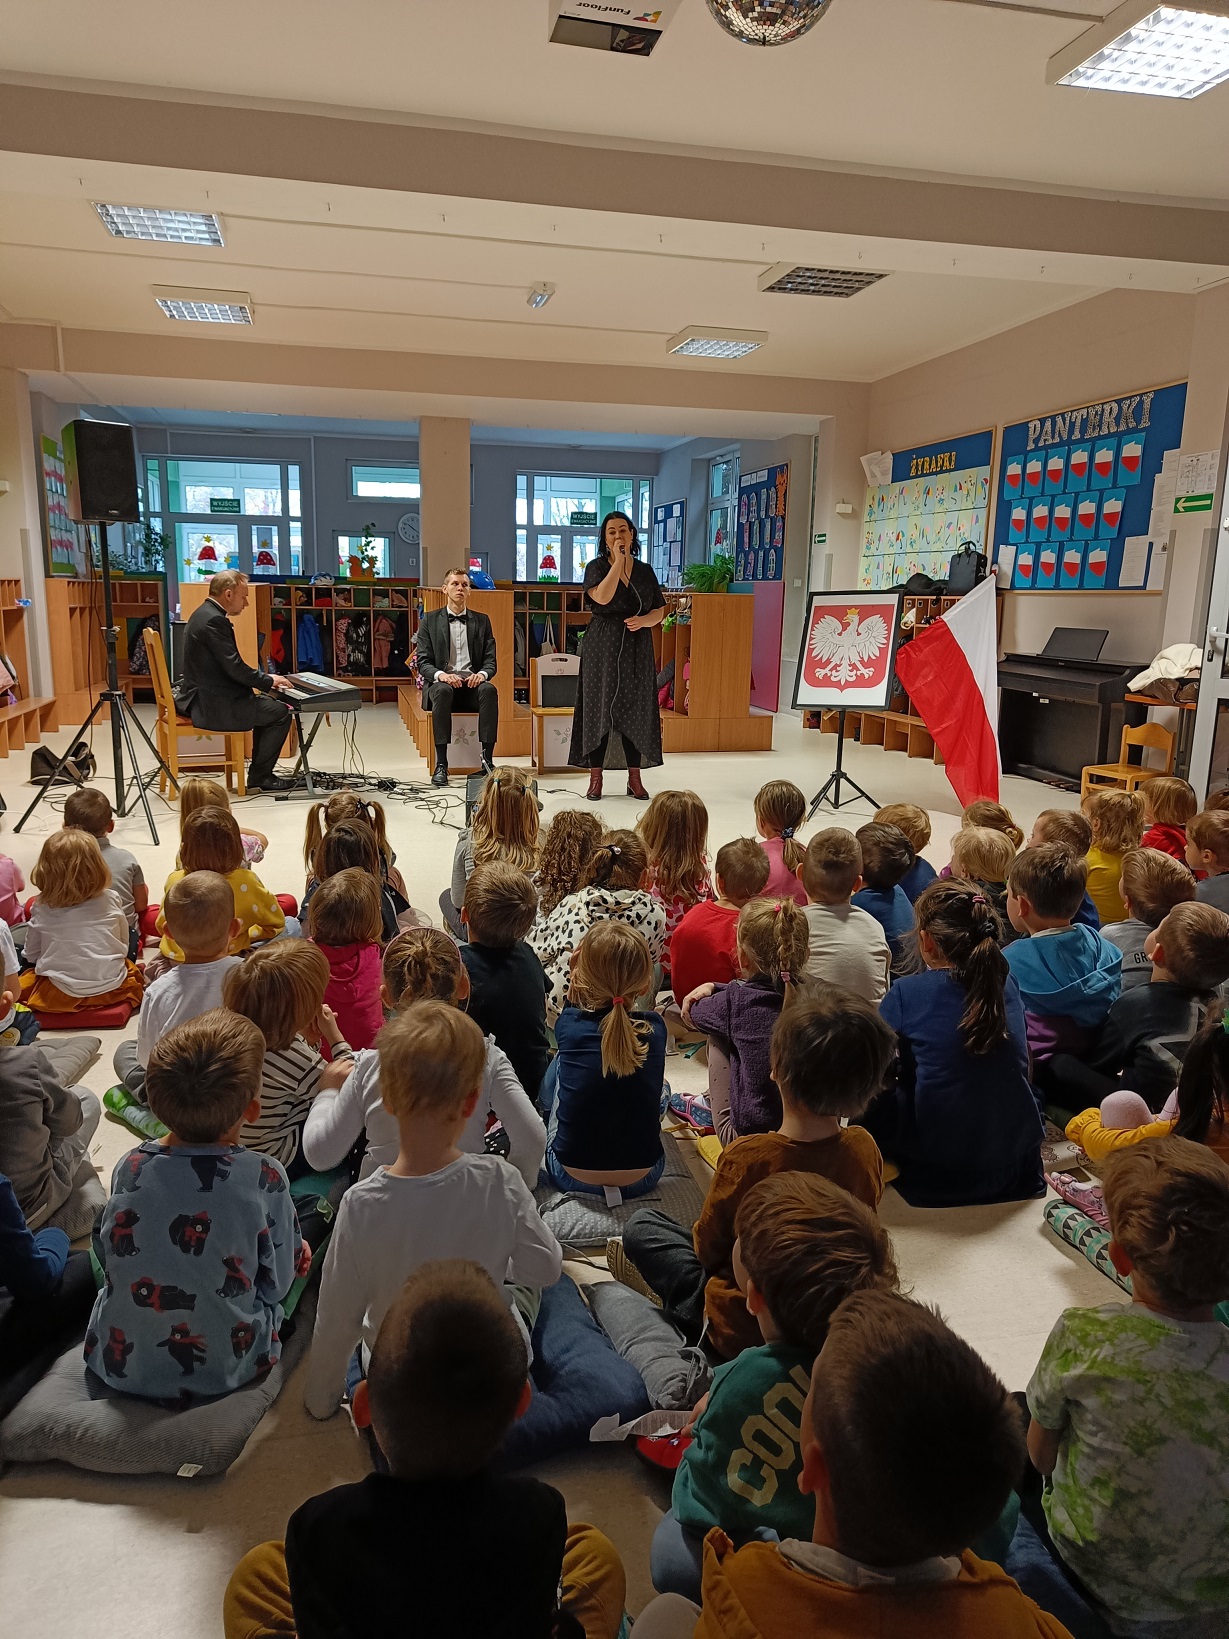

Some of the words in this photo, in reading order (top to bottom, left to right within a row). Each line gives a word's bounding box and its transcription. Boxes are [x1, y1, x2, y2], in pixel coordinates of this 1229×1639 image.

[1027, 391, 1155, 451] PANTERKI
[909, 452, 957, 476] ŻYRAFKI
[1134, 952, 1148, 963] GR
